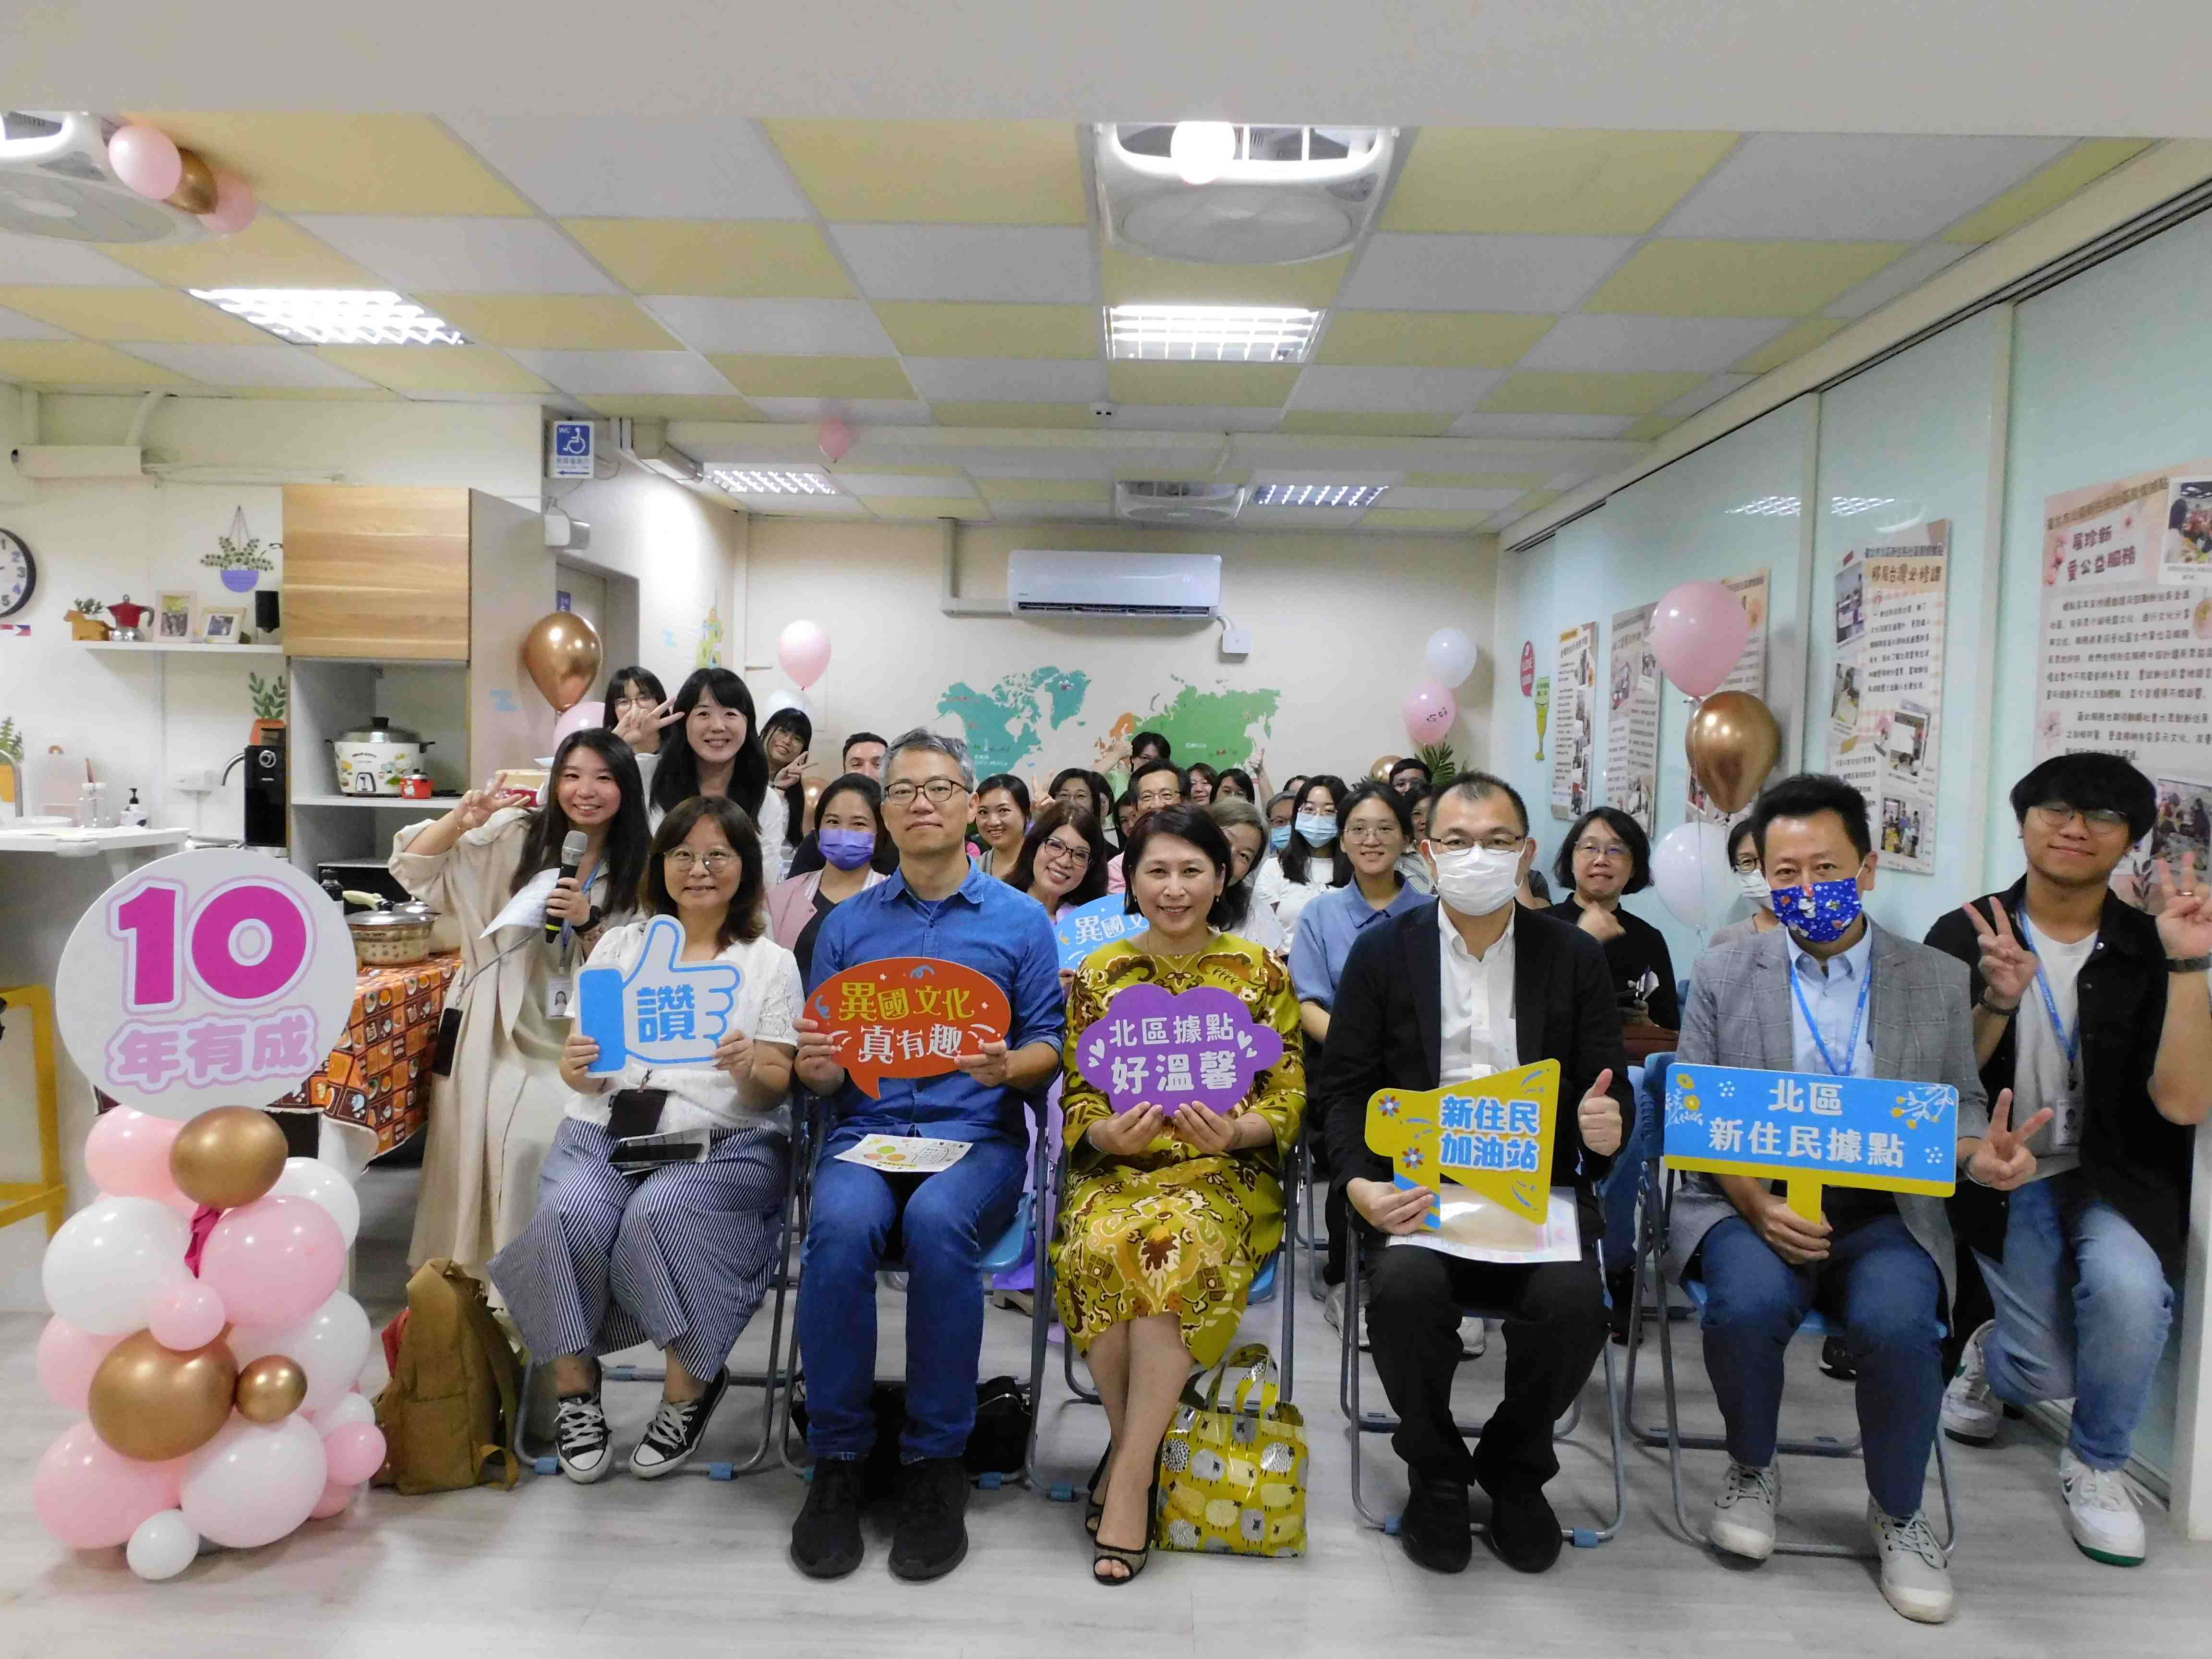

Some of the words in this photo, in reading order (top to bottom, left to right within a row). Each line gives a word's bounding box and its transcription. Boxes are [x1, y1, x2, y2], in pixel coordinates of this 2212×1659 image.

[11, 552, 21, 563] 2
[16, 566, 26, 578] 3
[1, 594, 11, 606] 5
[114, 882, 310, 1008] 10
[637, 984, 696, 1044] 讚
[838, 982, 975, 1022] 異國文化
[857, 1023, 963, 1064] 真有趣
[1109, 1012, 1234, 1047] 北區據點
[115, 1014, 313, 1086] 年有成
[1111, 1050, 1238, 1094] 好溫馨
[1441, 1095, 1539, 1134] 新住民
[1768, 1078, 1843, 1117] 北區
[1440, 1133, 1538, 1171] 加油站
[1708, 1117, 1905, 1169] 新住民據點
